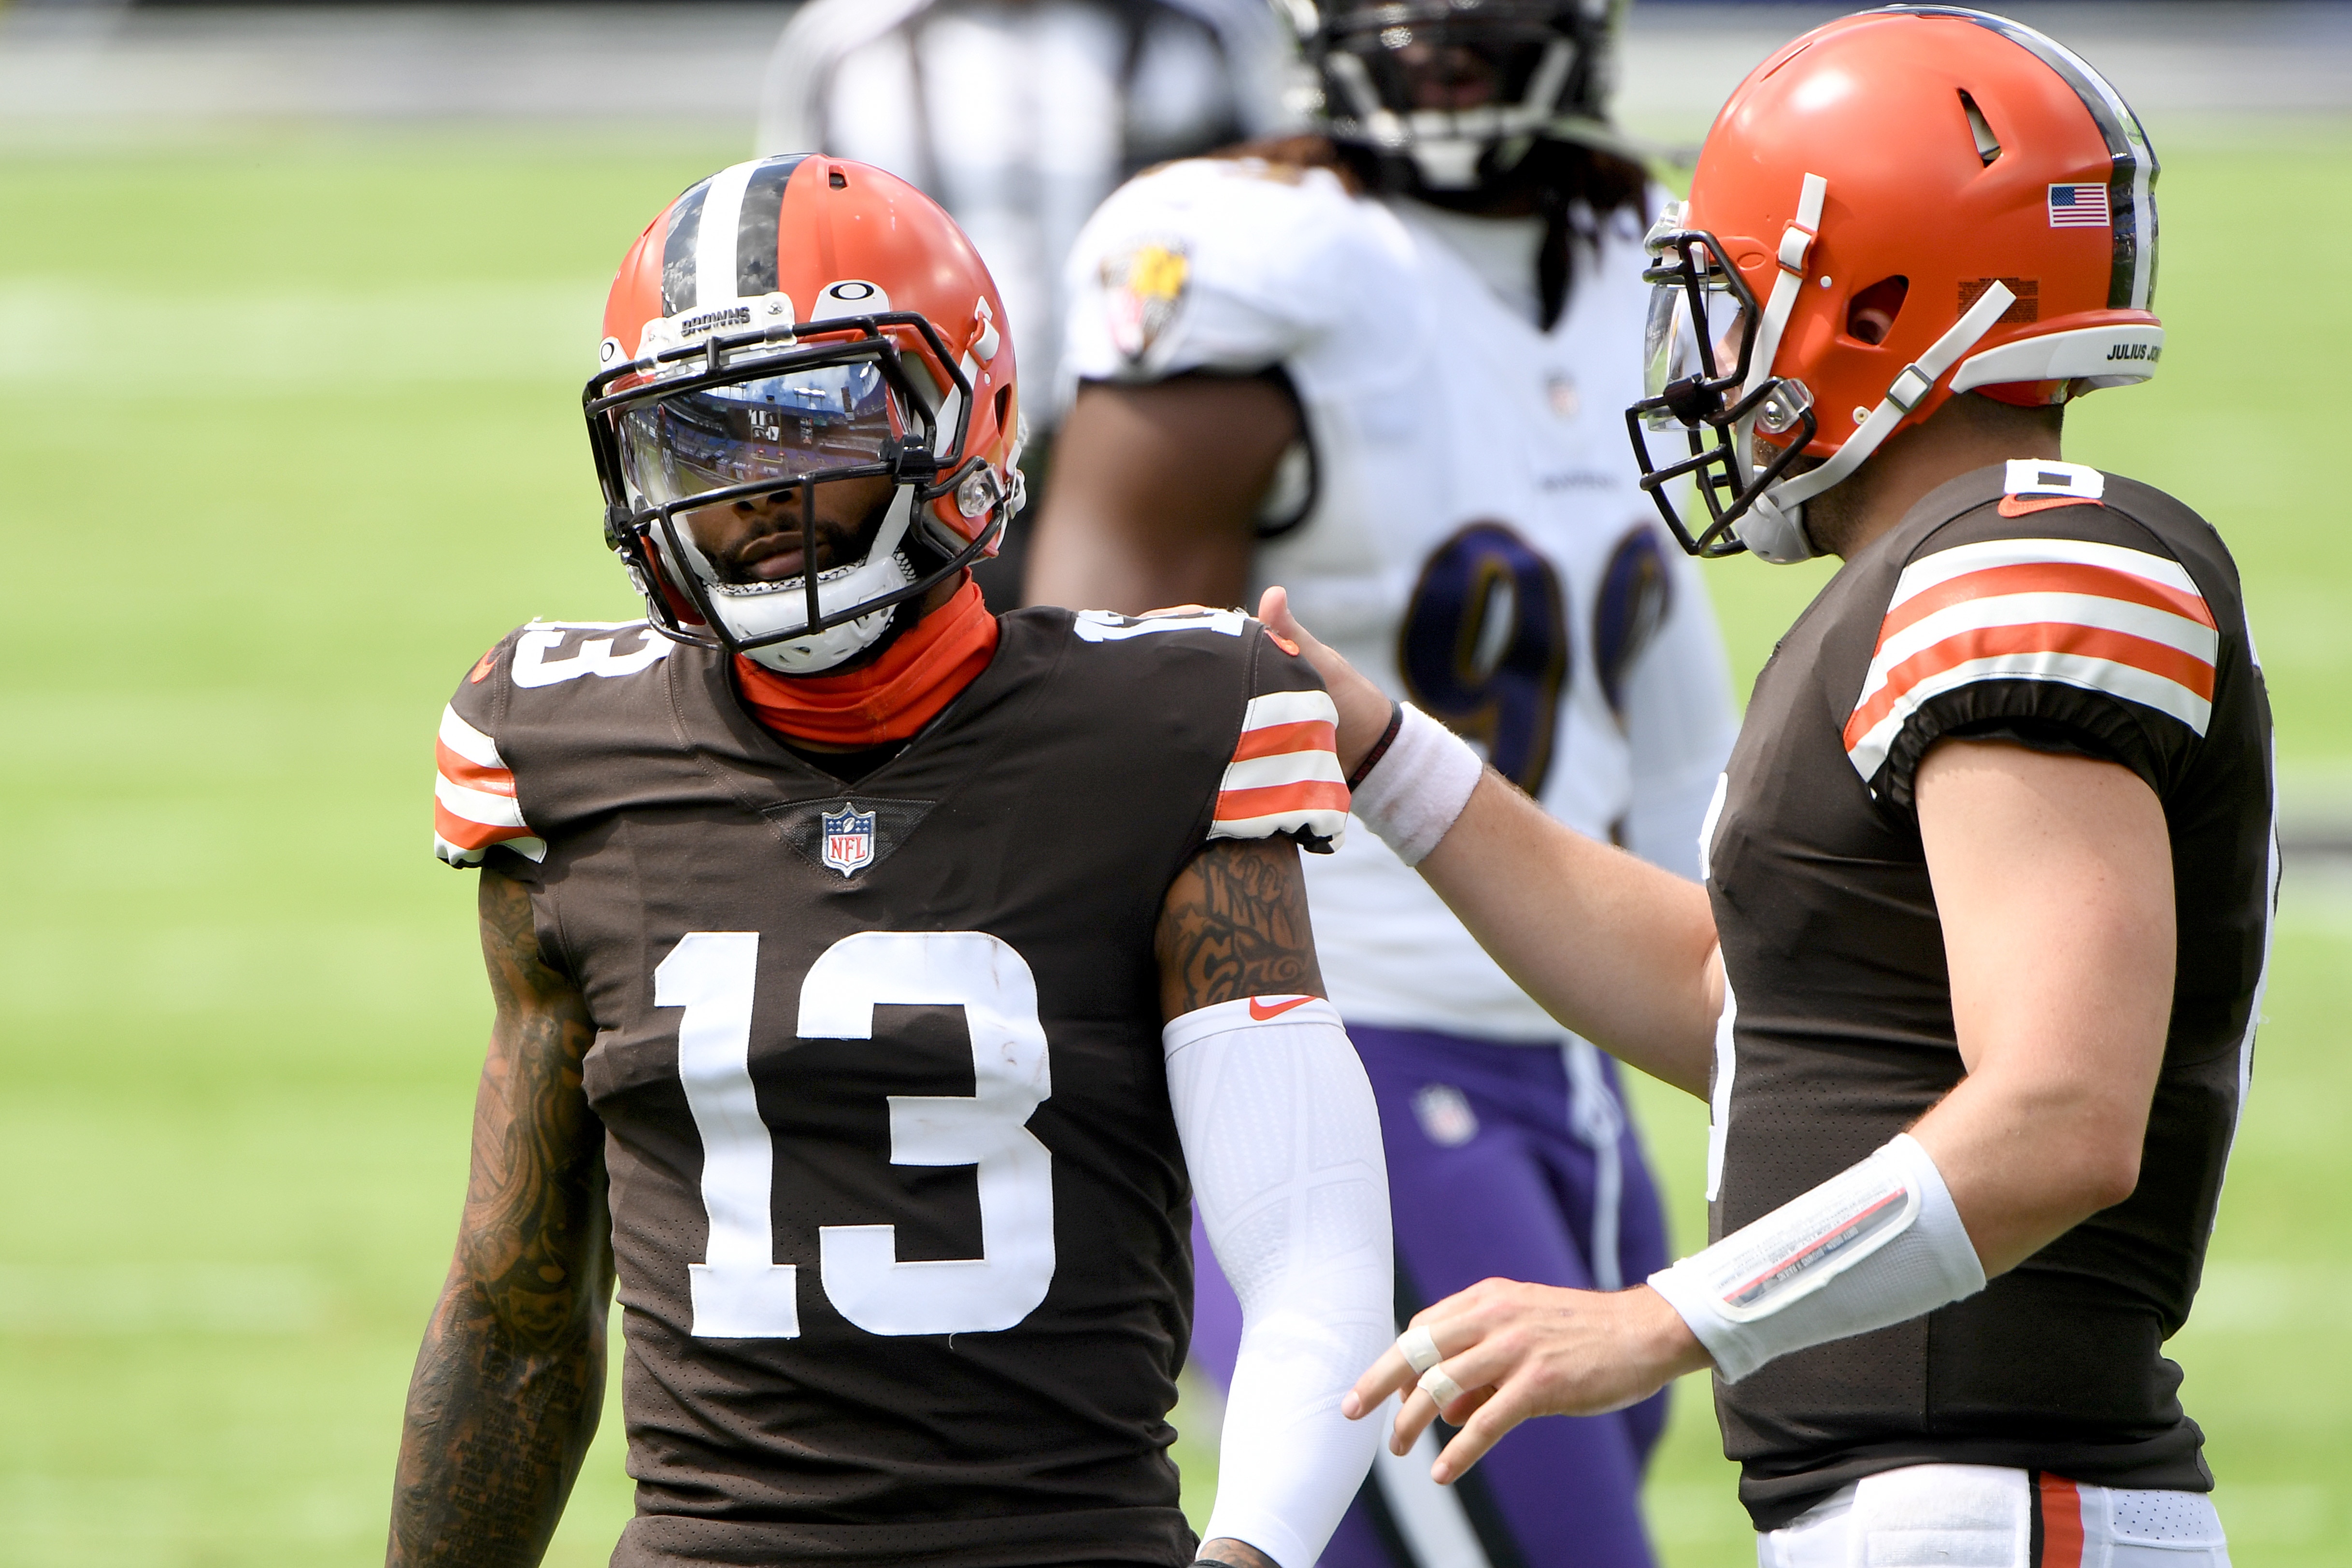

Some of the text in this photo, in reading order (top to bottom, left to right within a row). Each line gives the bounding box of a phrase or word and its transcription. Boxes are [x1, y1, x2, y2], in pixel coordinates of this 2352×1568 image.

[681, 306, 751, 338] BROWNS
[2107, 343, 2147, 361] JULIUS
[830, 836, 866, 862] NFL
[654, 931, 1056, 1338] 13
